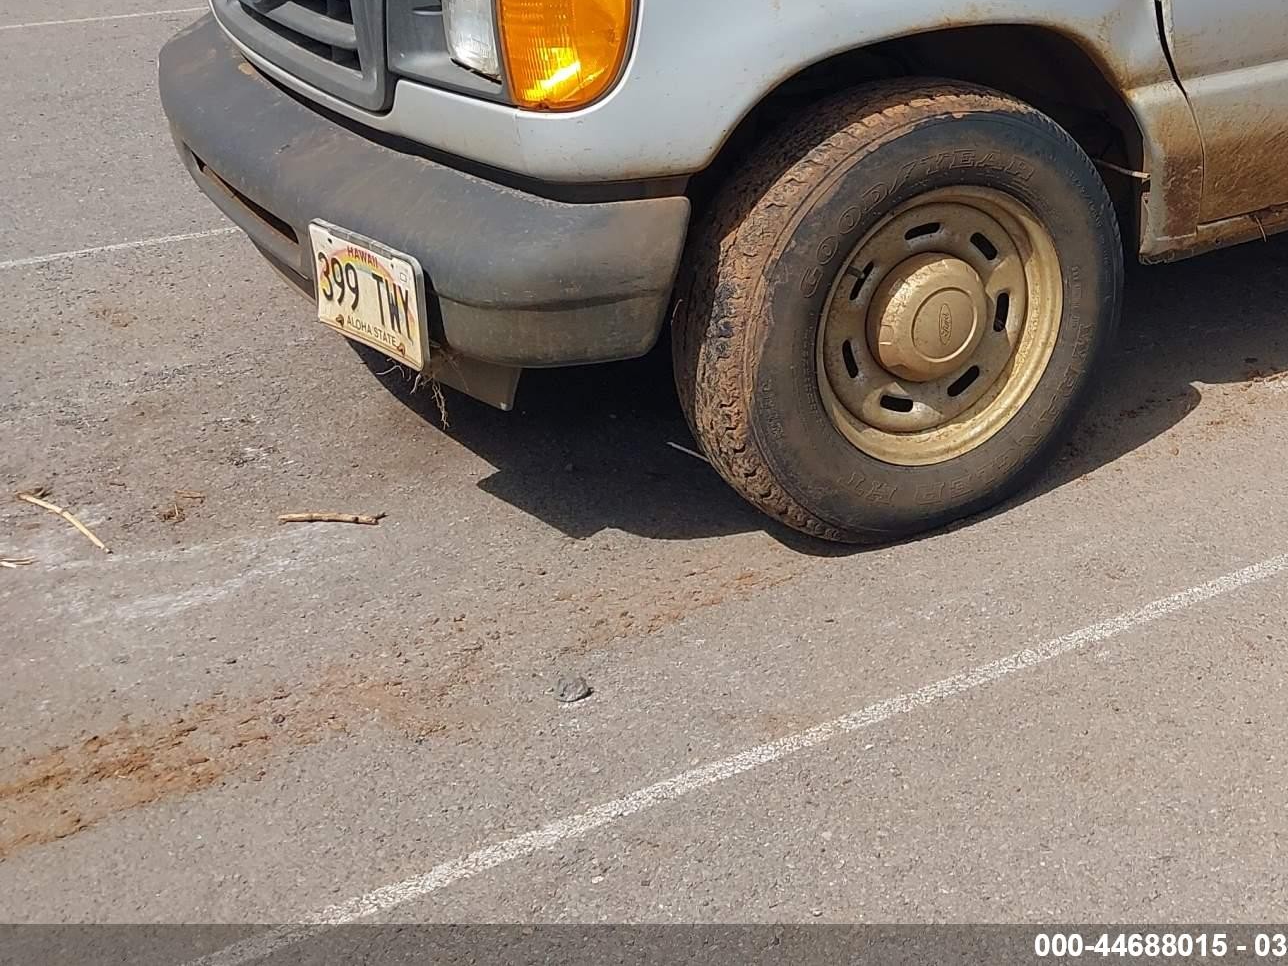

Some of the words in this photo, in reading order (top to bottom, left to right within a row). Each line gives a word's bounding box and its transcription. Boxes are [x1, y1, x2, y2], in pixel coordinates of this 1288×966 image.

[800, 149, 1036, 298] GOODYEAR
[318, 251, 359, 311] 399
[372, 273, 413, 345] TWY
[347, 315, 372, 337] ALOHA
[373, 327, 397, 348] STATE
